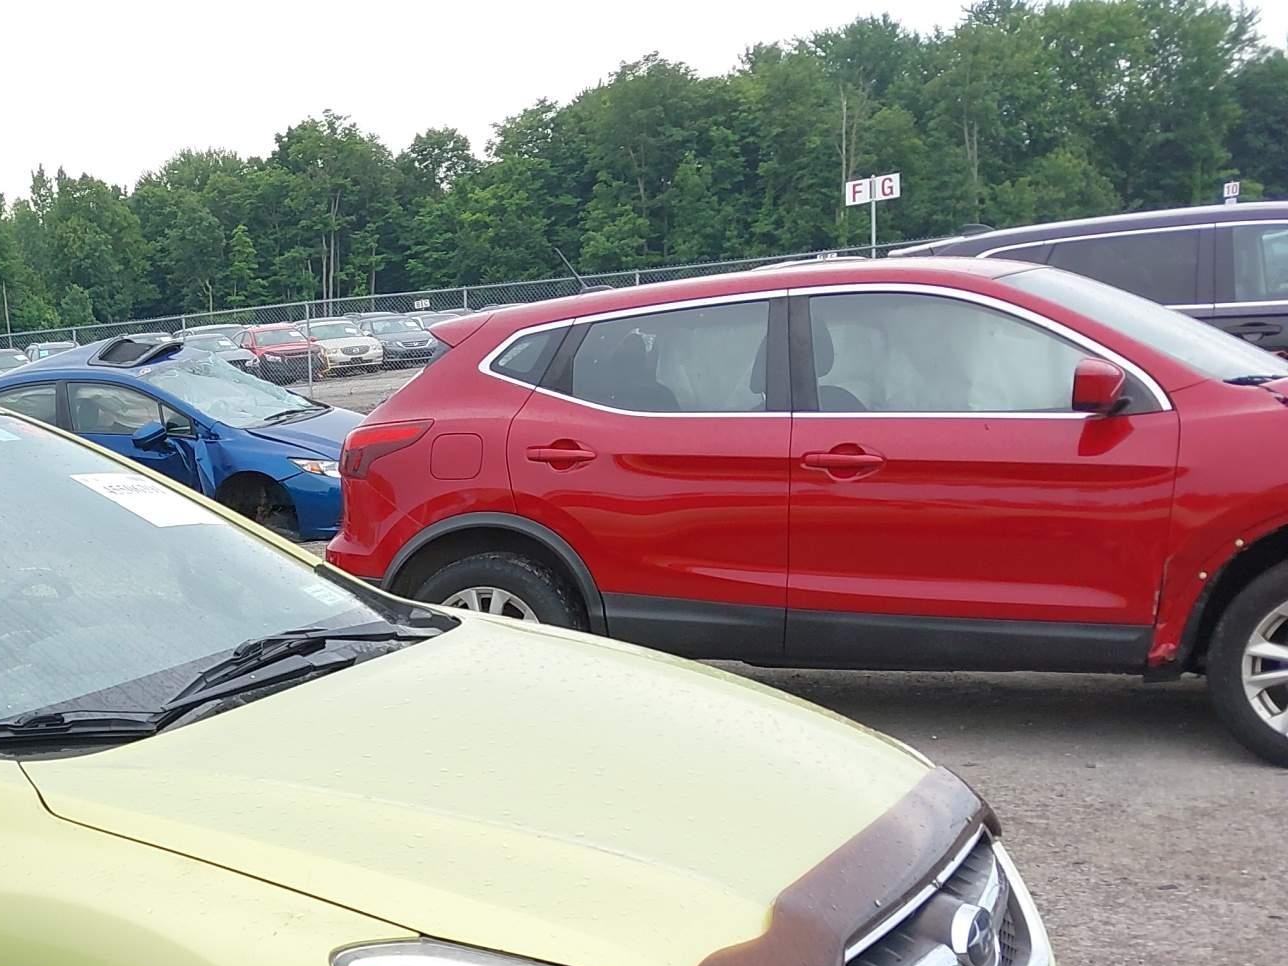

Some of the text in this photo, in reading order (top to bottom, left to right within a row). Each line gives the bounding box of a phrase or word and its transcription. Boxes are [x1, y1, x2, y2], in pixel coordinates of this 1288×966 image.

[852, 178, 894, 202] F G
[1226, 184, 1238, 195] 10
